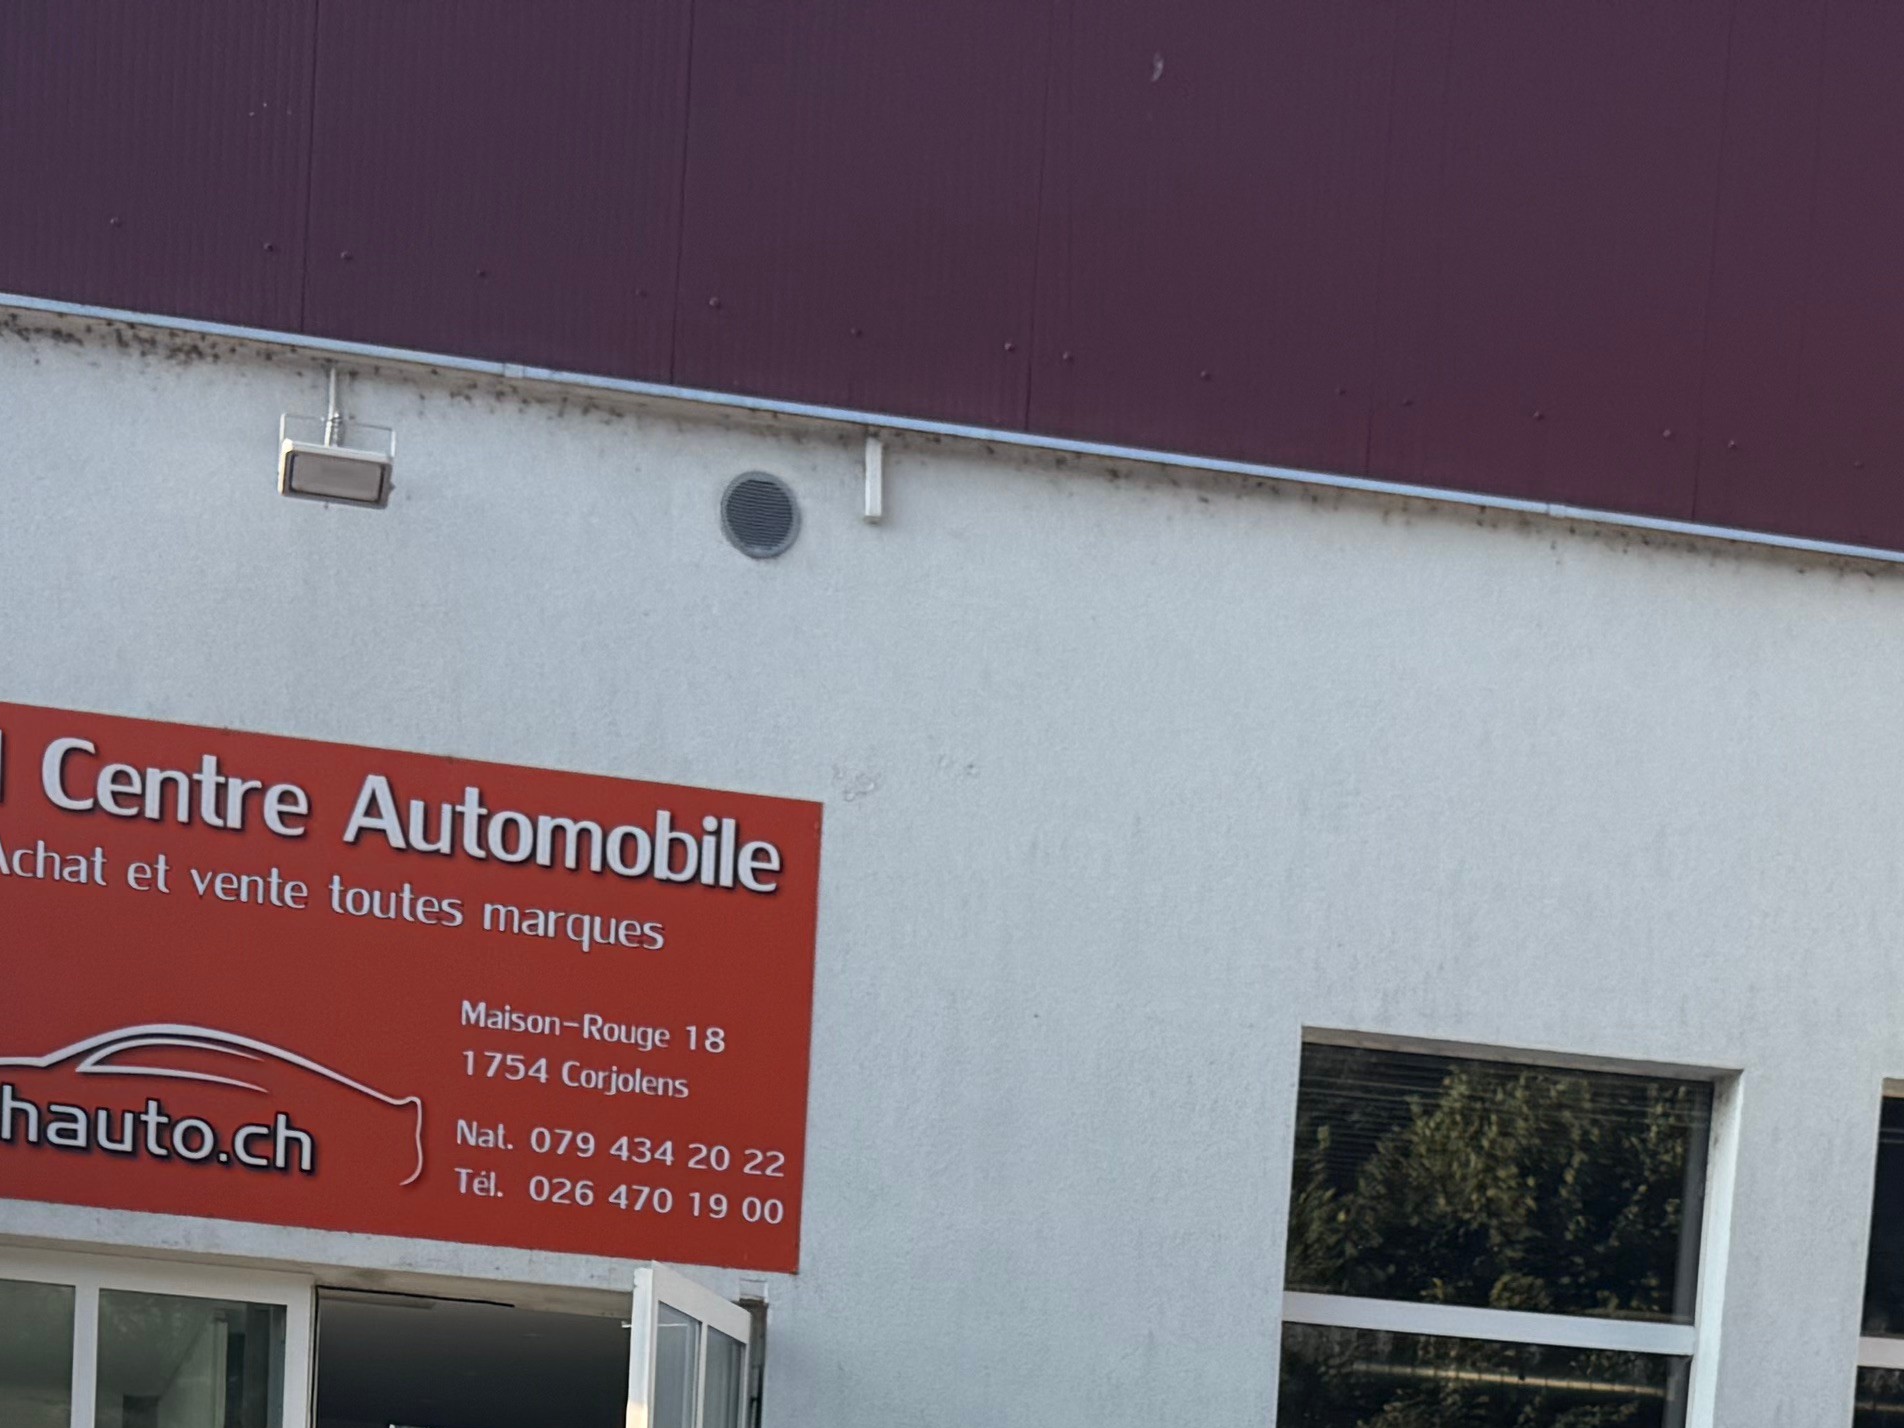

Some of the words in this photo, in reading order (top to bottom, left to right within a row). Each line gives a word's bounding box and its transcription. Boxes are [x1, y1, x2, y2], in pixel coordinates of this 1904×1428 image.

[41, 737, 309, 837] Centre
[342, 774, 782, 893] Automobile
[127, 854, 171, 894] et
[190, 867, 309, 910] vente
[328, 874, 464, 928] toutes
[483, 903, 665, 953] marques
[461, 999, 671, 1052] Maison-Rouge
[686, 1025, 726, 1053] 18
[463, 1050, 549, 1084] 1754
[561, 1060, 690, 1100] Corjolens
[456, 1119, 514, 1150] Nat.
[530, 1127, 595, 1158] 079
[609, 1135, 674, 1166] 434
[687, 1143, 730, 1171] 20
[743, 1149, 785, 1177] 22
[454, 1167, 504, 1198] Tél.
[529, 1175, 594, 1206] 026
[608, 1184, 673, 1214] 470
[689, 1191, 729, 1219] 19
[742, 1196, 784, 1224] 00
